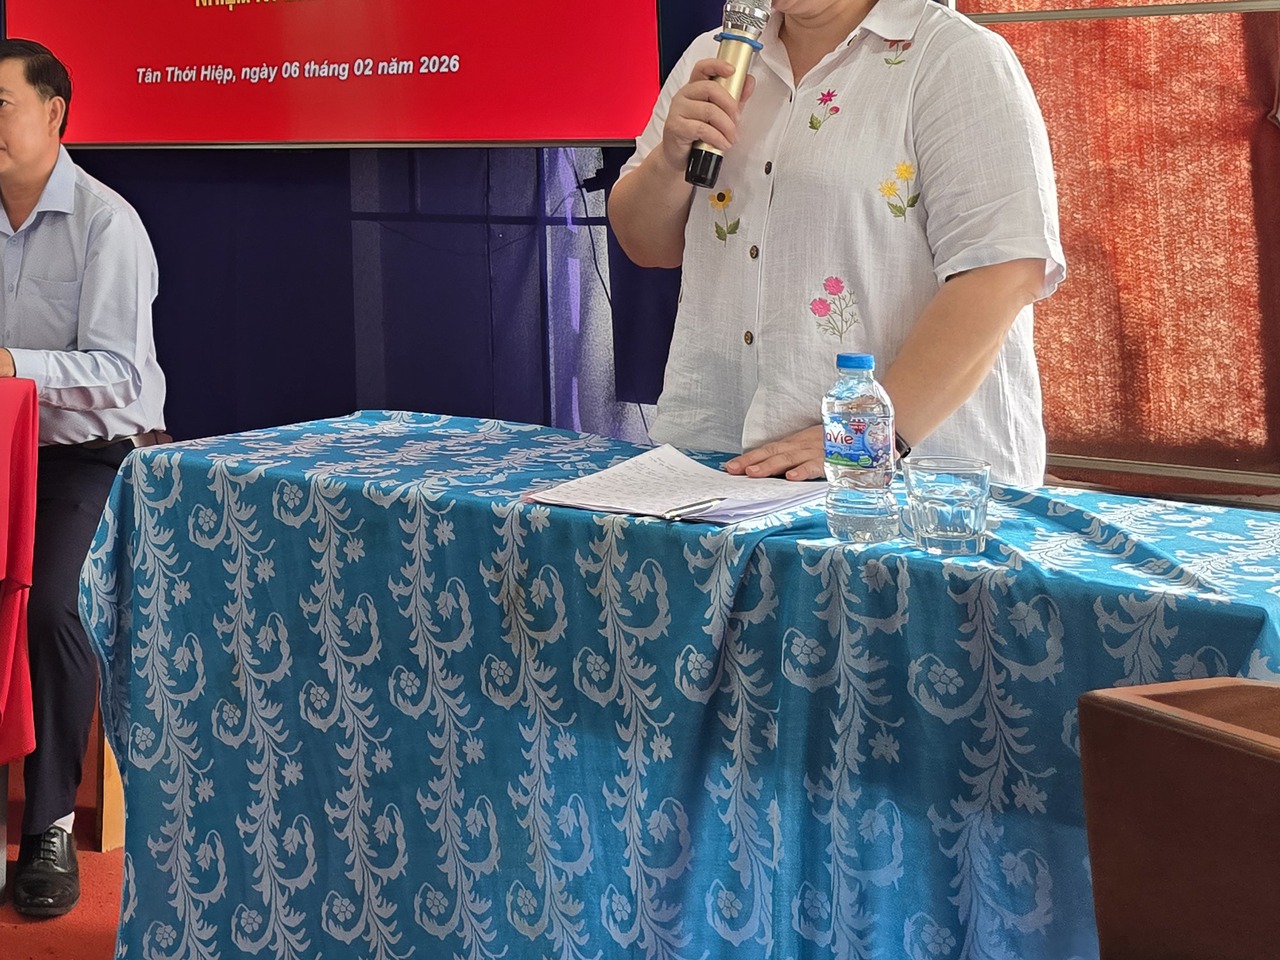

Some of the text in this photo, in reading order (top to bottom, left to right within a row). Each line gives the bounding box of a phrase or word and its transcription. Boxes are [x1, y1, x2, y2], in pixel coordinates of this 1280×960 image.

[136, 54, 460, 84] Tân Thới Hiệp, ngày 06 tháng 02 năm 2026
[825, 429, 854, 445] aVie
